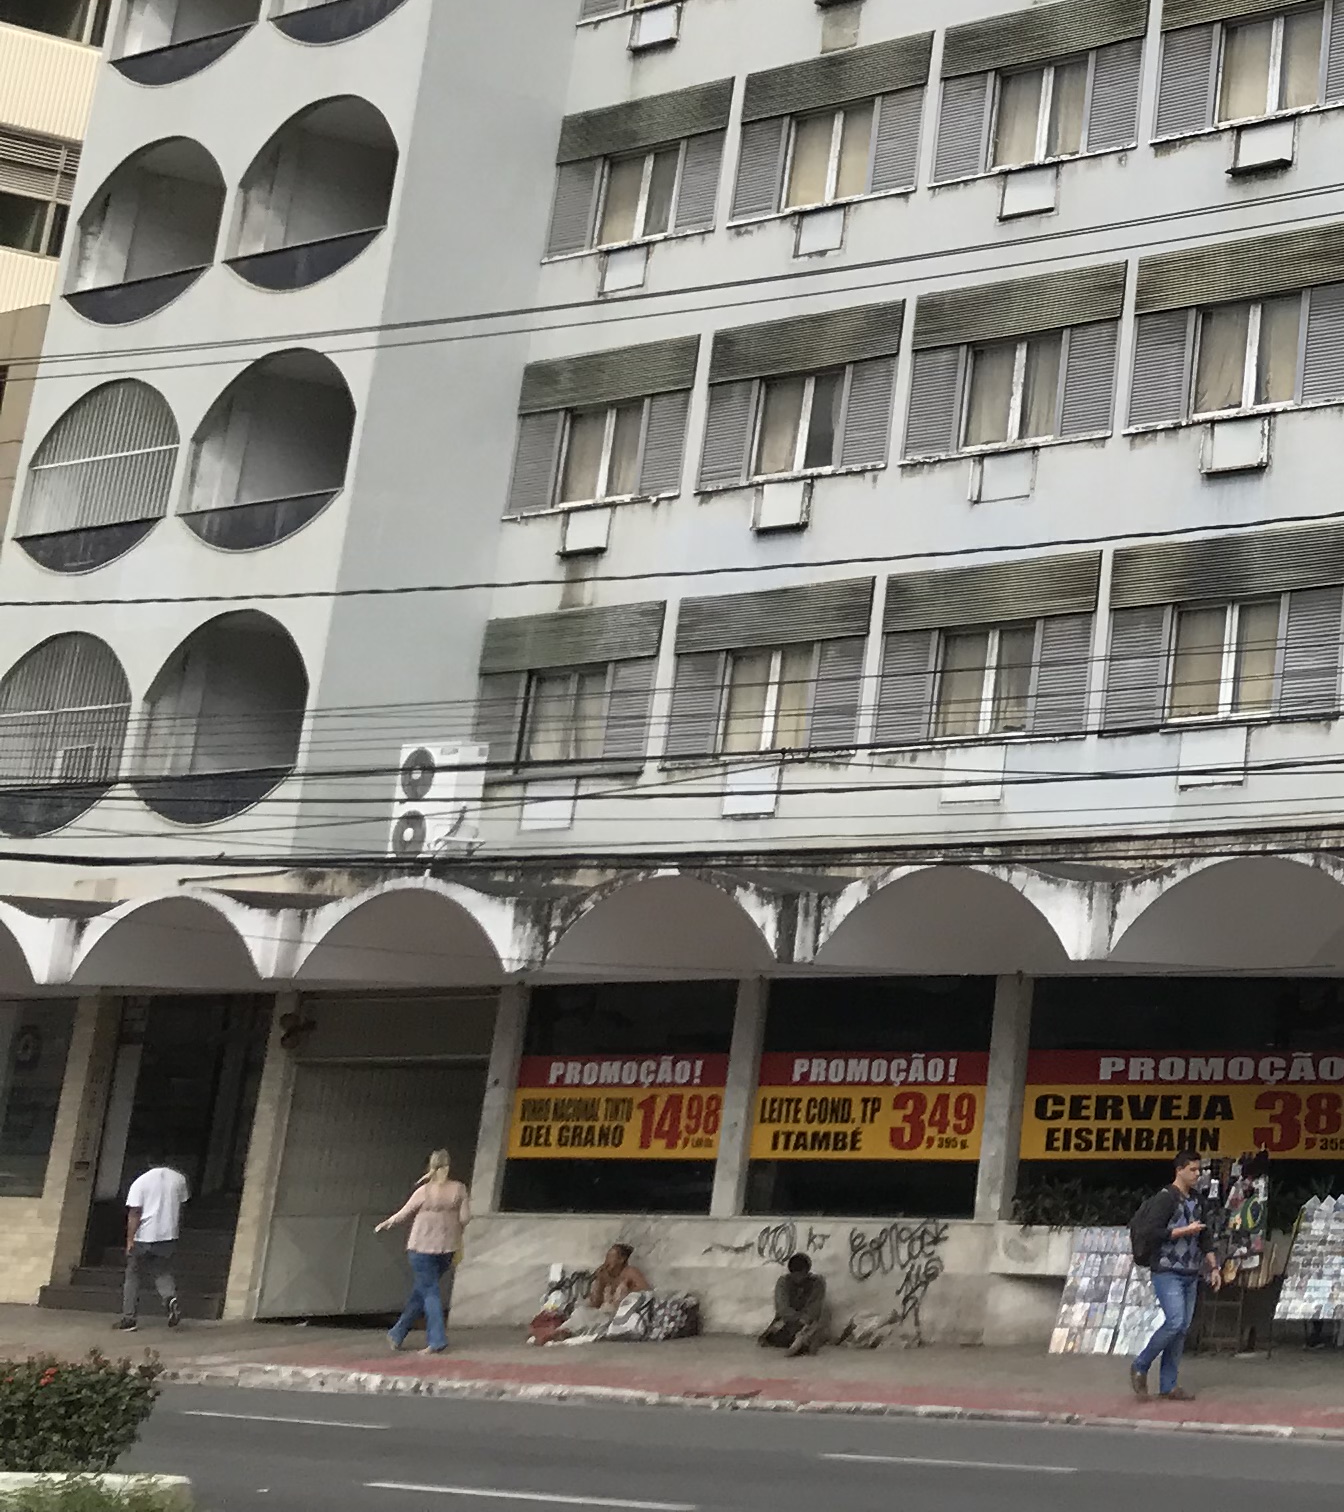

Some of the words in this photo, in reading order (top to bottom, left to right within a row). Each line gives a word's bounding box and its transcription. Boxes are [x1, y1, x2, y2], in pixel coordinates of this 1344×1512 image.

[548, 1055, 704, 1088] PROMOÇÃO!
[792, 1053, 959, 1086] PROMOÇÃO!
[637, 1093, 722, 1150] 14,98
[759, 1096, 802, 1124] LEITE
[805, 1096, 856, 1125] COND.
[860, 1096, 882, 1124] TP
[889, 1091, 977, 1151] 3,49
[1034, 1093, 1234, 1121] CERVEJA
[520, 1124, 552, 1147] DEL
[557, 1124, 625, 1148] GRANO
[770, 1126, 863, 1151] ITAMBÉ
[1045, 1127, 1220, 1152] EISENBAHN
